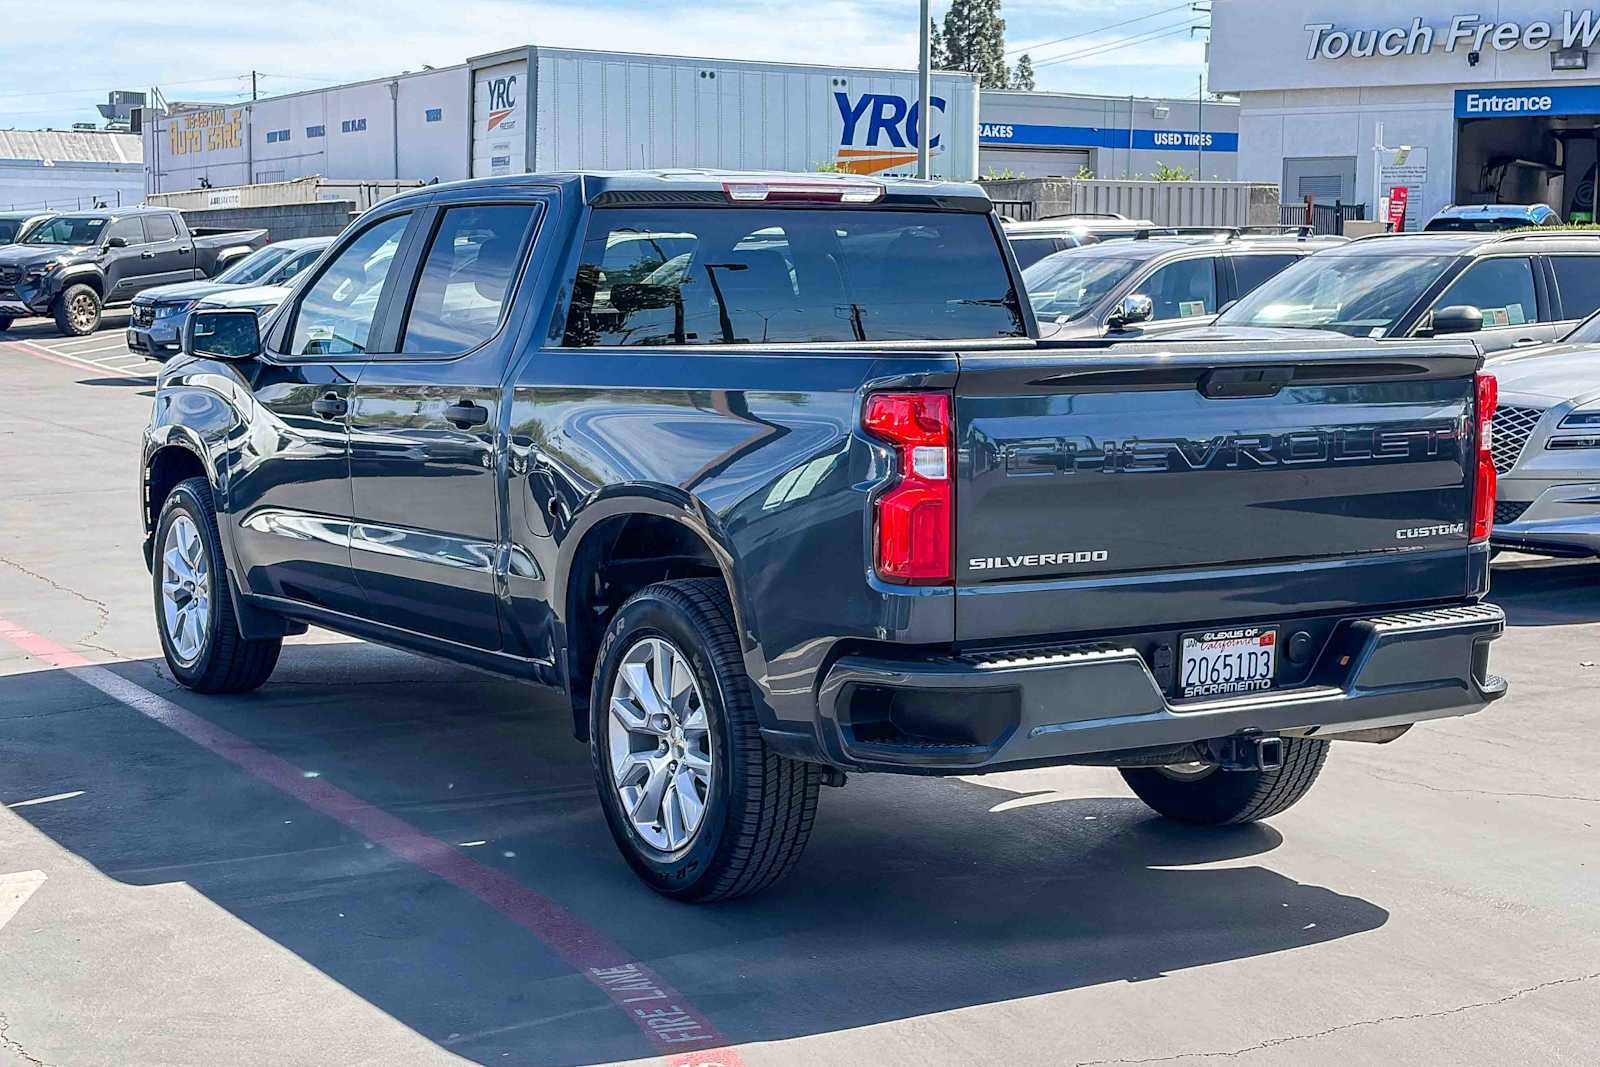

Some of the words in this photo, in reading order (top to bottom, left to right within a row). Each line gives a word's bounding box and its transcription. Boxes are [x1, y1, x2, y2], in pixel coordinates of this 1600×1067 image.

[1305, 17, 1433, 60] Touch
[1445, 14, 1552, 52] Free
[488, 76, 516, 111] YRC
[1466, 94, 1552, 112] Entrance
[834, 92, 946, 149] YRC
[979, 125, 1014, 138] RAKES
[1154, 133, 1182, 145] USED
[1184, 133, 1212, 146] TIRES
[1006, 429, 1452, 477] CHEVROLET
[1396, 523, 1464, 539] CUSTOM
[969, 550, 1109, 570] SILVERADO
[1210, 630, 1244, 640] LEXUS
[1245, 628, 1259, 637] OF
[1186, 651, 1271, 686] 20651D3
[1184, 679, 1271, 697] SACRAMENTO
[590, 963, 668, 1003] LANE
[634, 1005, 713, 1043] FIRE
